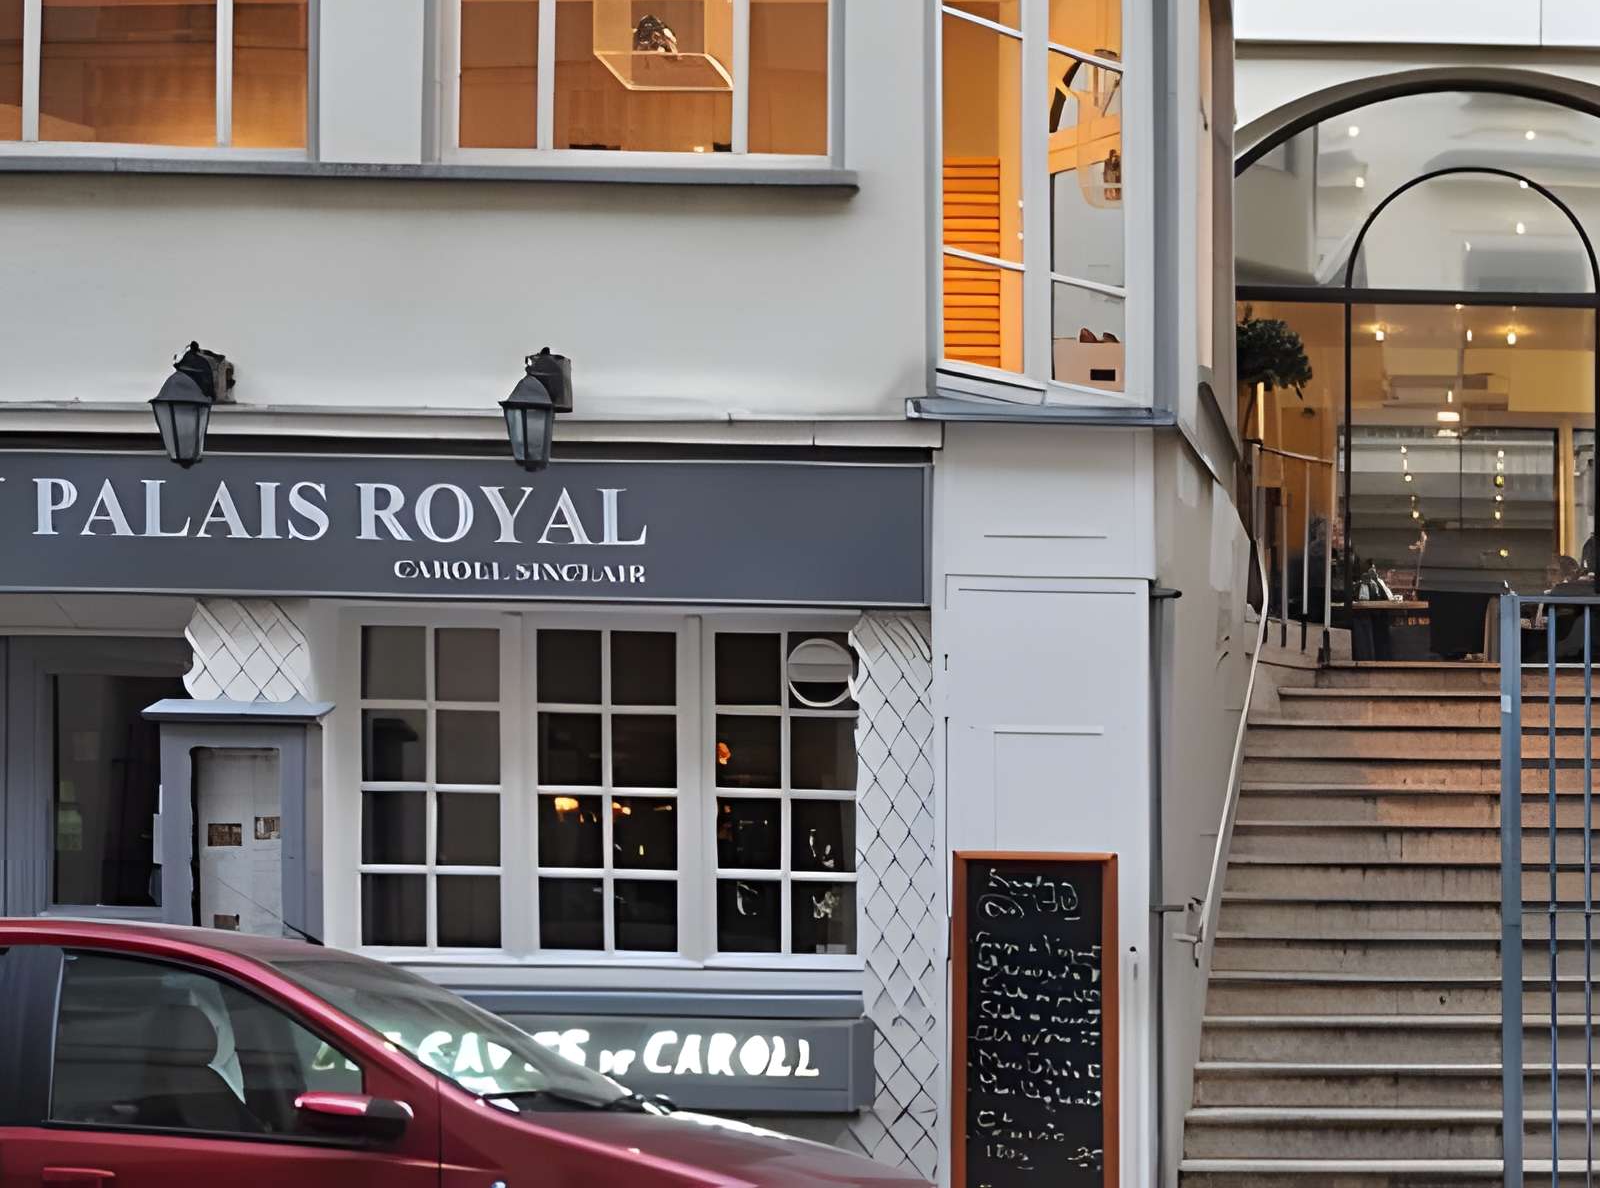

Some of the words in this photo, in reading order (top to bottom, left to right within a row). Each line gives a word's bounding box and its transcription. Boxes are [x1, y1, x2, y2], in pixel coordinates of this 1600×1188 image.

[31, 477, 330, 541] PALAIS
[354, 483, 647, 545] ROYAL
[643, 1030, 820, 1077] CAROLL
